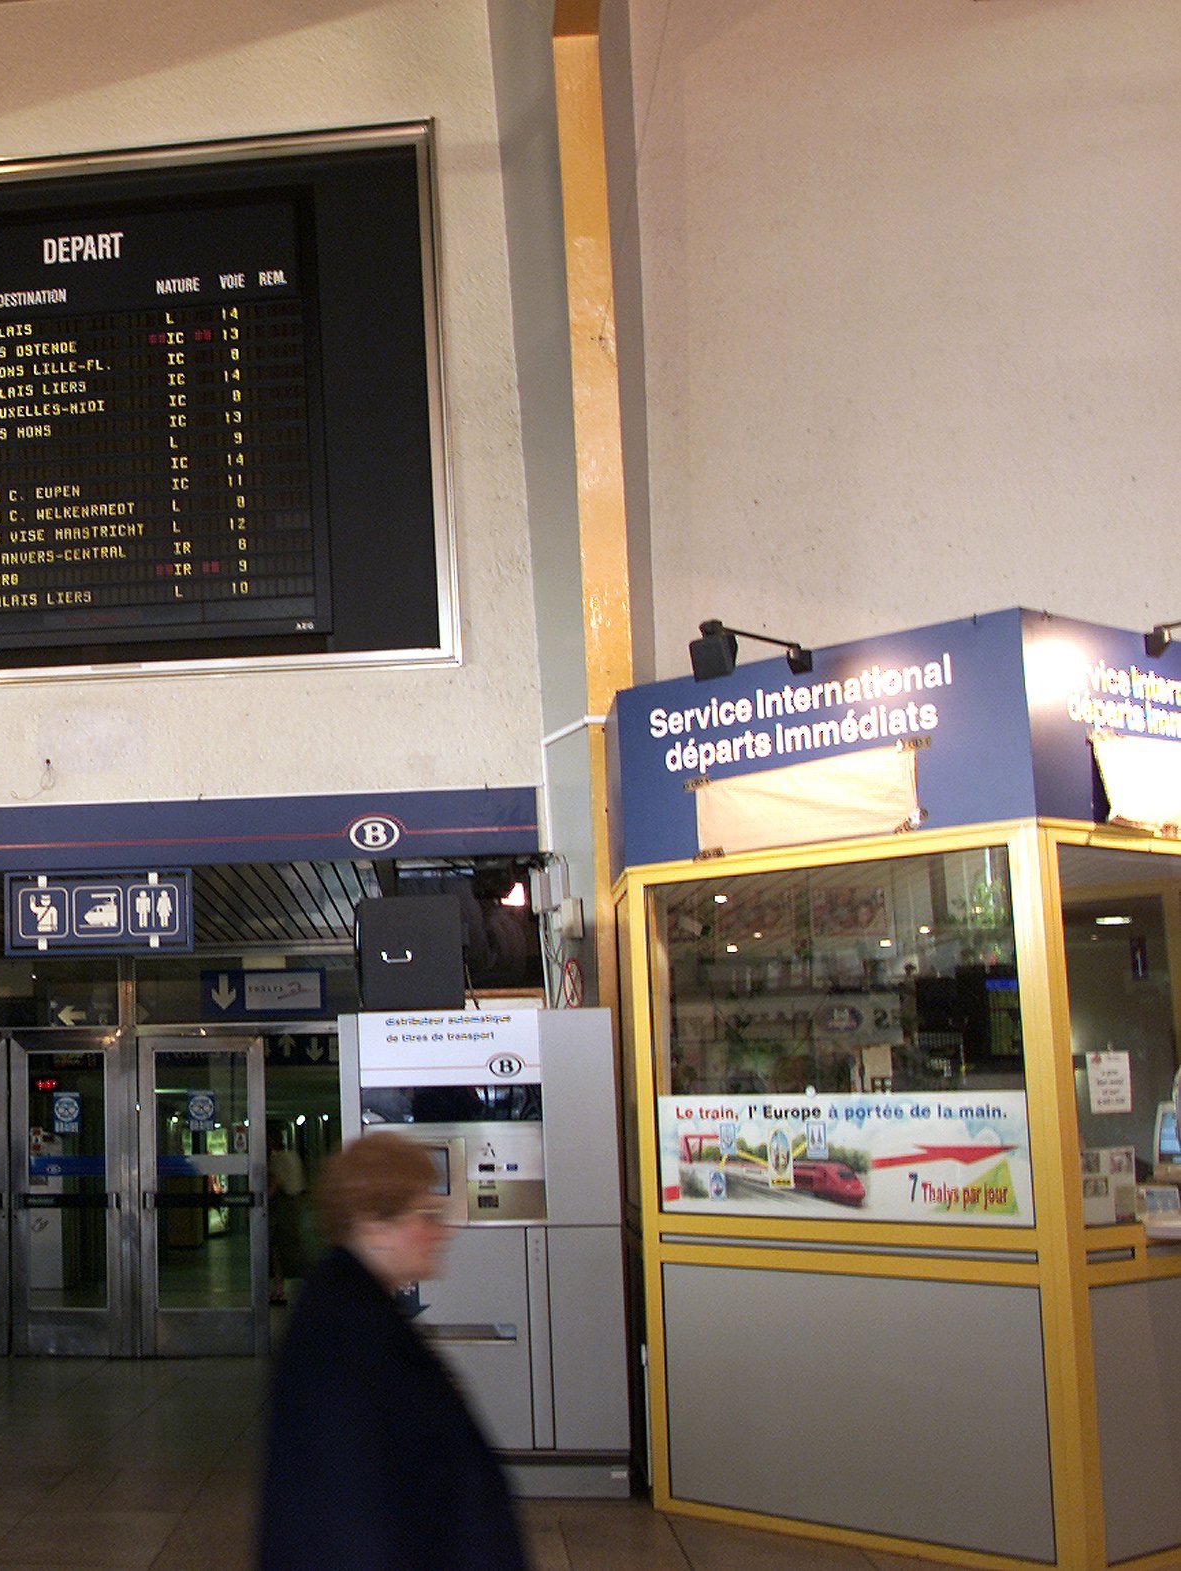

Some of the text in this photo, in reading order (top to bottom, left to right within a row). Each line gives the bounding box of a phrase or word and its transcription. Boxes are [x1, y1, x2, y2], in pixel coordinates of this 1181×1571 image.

[44, 232, 123, 264] DEPART
[157, 277, 199, 294] NATURE
[219, 273, 245, 289] VOIE
[166, 312, 174, 324] L
[222, 308, 238, 320] 14
[16, 341, 76, 357] OSTENDE
[167, 332, 183, 344] IC
[34, 360, 110, 375] LILLE-FL.
[168, 352, 184, 364] IC
[43, 382, 86, 394] LIERS
[168, 373, 185, 386] IC
[225, 368, 239, 382] 14
[169, 395, 186, 406] IC
[17, 425, 51, 438] MONS
[170, 414, 186, 427] IC
[170, 436, 178, 448] L
[171, 457, 187, 469] IC
[228, 453, 243, 466] 14
[36, 486, 79, 498] EUPEN
[173, 478, 189, 490] IC
[228, 474, 241, 486] 11
[37, 502, 134, 520] WELKENRAEDT
[173, 500, 180, 512] L
[11, 529, 44, 542] VISE
[55, 524, 143, 540] MAASTRICHT
[173, 521, 180, 533] L
[230, 518, 245, 530] 12
[1, 546, 126, 564] ANVERS-CENTRAL
[174, 542, 191, 554] IR
[175, 563, 191, 575] IR
[239, 560, 247, 572] 9
[47, 592, 91, 604] LIERS
[175, 586, 183, 597] L
[233, 582, 248, 594] 10
[649, 654, 953, 740] Service International
[666, 729, 771, 773] départs
[385, 1014, 511, 1028] distributeur automatique
[402, 1032, 427, 1042] titres
[432, 1032, 443, 1042] de
[447, 1031, 495, 1043] transport
[676, 1106, 692, 1119] Le
[699, 1107, 739, 1121] train,
[763, 1105, 821, 1121] Europe
[829, 1104, 837, 1119] à
[845, 1105, 904, 1121] portée
[910, 1104, 930, 1119] de
[937, 1104, 953, 1119] la
[959, 1105, 1007, 1119] main.
[909, 1173, 1007, 1212] 7 Thalys par jour
